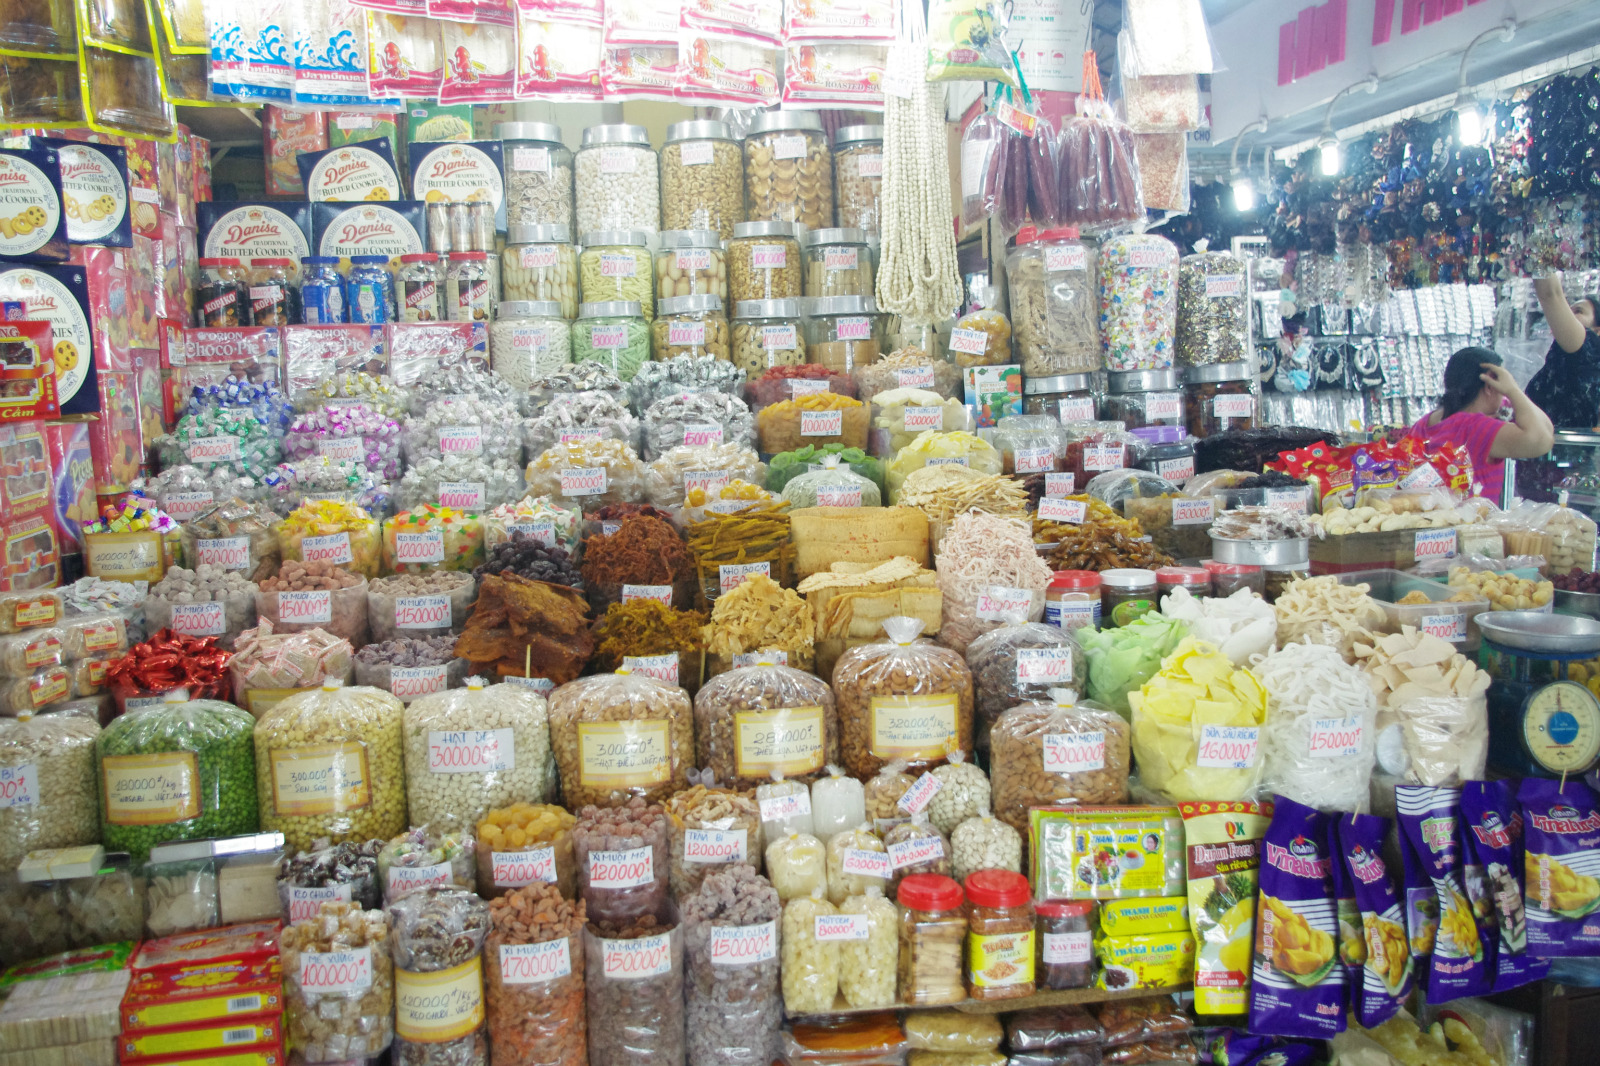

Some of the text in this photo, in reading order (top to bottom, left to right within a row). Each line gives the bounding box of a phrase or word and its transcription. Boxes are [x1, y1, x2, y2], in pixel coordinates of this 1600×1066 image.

[324, 159, 370, 186] Danisa
[430, 158, 478, 178] Danisa
[83, 184, 114, 194] COOKIES
[321, 178, 384, 197] BUTTER COOKIES
[427, 180, 489, 188] BUTTER COOKIES
[224, 220, 281, 245] Danisa
[339, 222, 395, 244] Danisa
[220, 246, 293, 256] BUTTER COOKIES
[335, 246, 407, 256] BUTTER COOKIES
[206, 292, 236, 311] KOPIKO
[406, 285, 435, 305] KOPIKO
[460, 282, 488, 304] KOPIKO
[1415, 537, 1453, 556] 100000đ
[280, 595, 330, 620] 150000đ
[398, 602, 450, 625] 150000đ
[172, 610, 223, 632] 150000đ
[391, 674, 446, 698] 150000đ
[1198, 738, 1258, 762] 160000đ
[1310, 727, 1362, 752] 150000đ
[1046, 741, 1104, 765] 300000đ
[494, 858, 552, 882] 150000đ
[1120, 904, 1178, 916] THANH LONG
[302, 960, 366, 987] 100000đ
